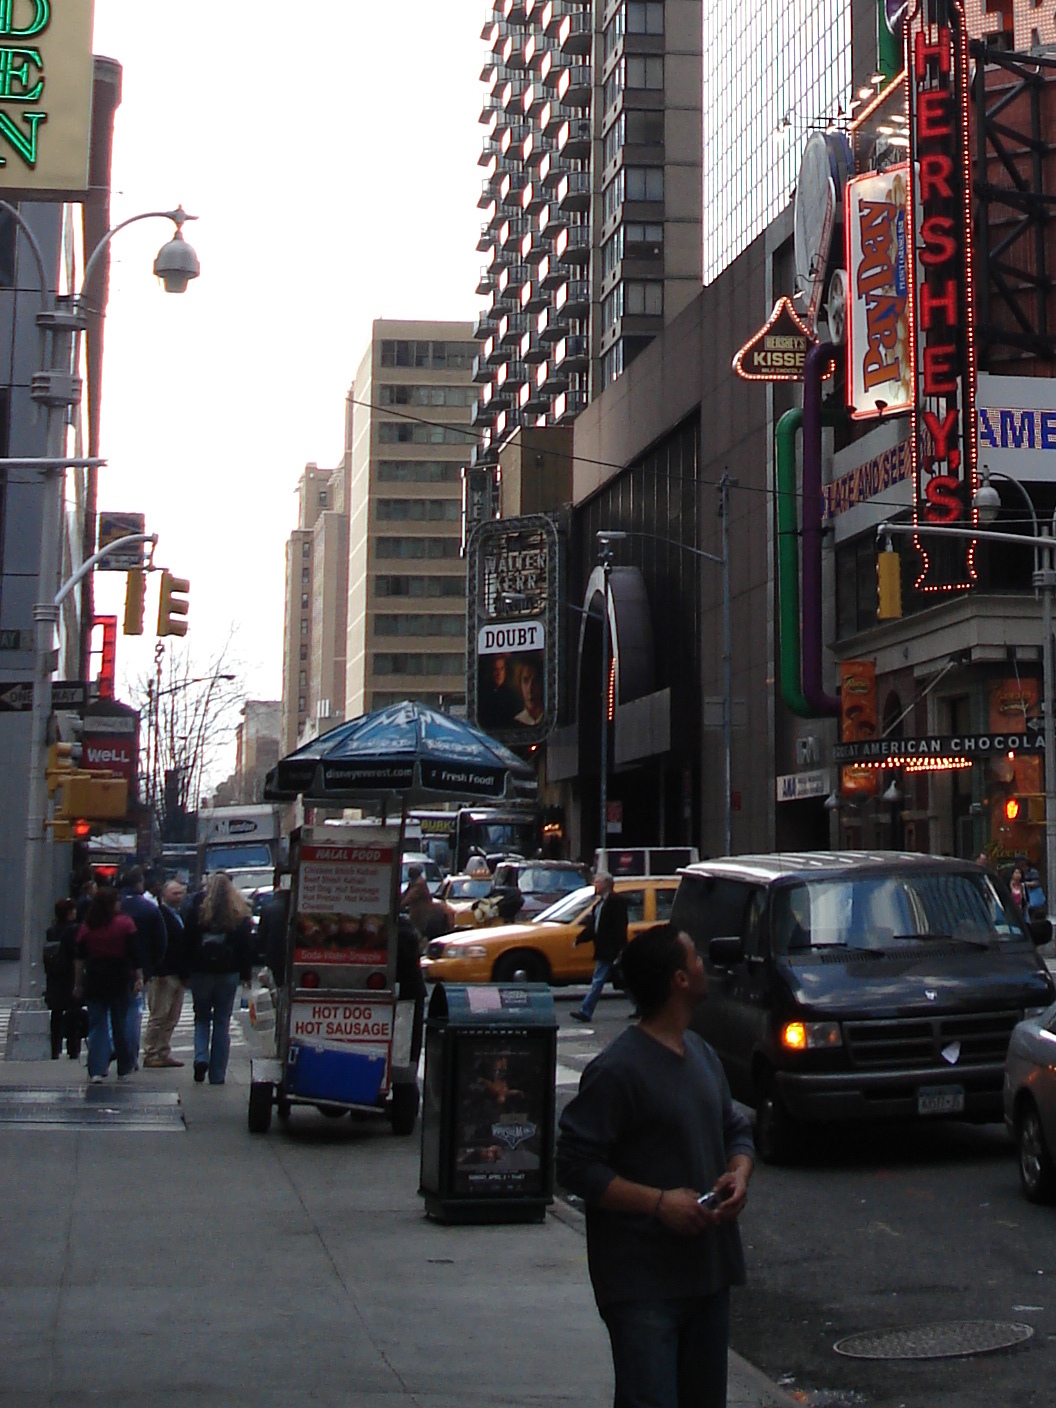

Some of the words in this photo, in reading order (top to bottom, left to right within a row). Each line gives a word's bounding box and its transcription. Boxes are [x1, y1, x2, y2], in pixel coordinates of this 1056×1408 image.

[914, 31, 964, 524] HERSHEY'S
[484, 627, 537, 649] DOUBT
[862, 739, 942, 755] AMERICAN
[441, 771, 468, 783] Fresh
[315, 849, 348, 860] HALAL
[351, 850, 382, 861] FOOD
[312, 1006, 339, 1019] HOT
[343, 1007, 372, 1020] DOG
[295, 1021, 323, 1035] HOT
[326, 1022, 389, 1036] SAUSAGE
